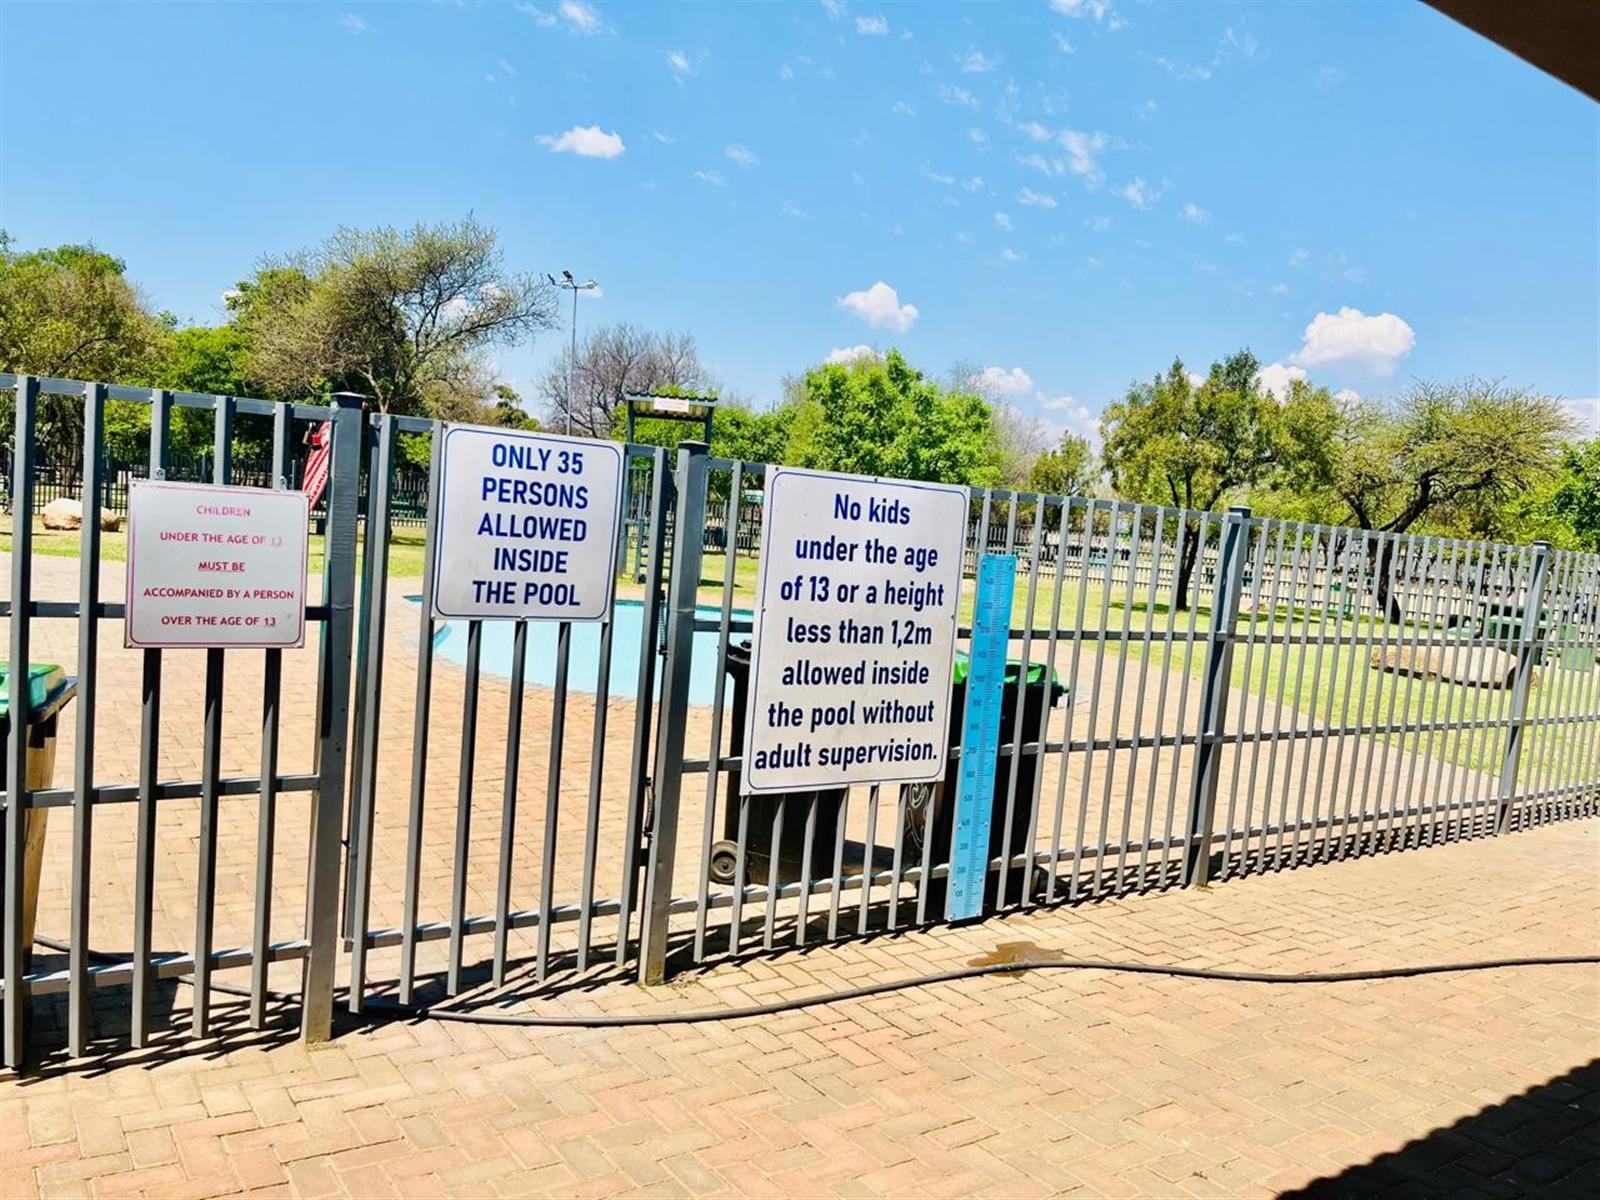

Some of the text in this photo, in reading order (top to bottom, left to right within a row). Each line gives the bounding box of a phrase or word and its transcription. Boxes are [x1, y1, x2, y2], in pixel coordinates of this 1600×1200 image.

[492, 444, 584, 475] ONLY 35
[482, 476, 588, 509] PERSONS
[196, 505, 251, 517] CHILDREN
[834, 493, 911, 525] No kids
[160, 532, 198, 542] UNDER
[202, 533, 224, 543] THE
[226, 534, 249, 544] AGE
[252, 536, 266, 545] OF
[478, 512, 588, 542] ALLOWED
[198, 562, 246, 572] MUST BE
[494, 547, 568, 574] INSIDE
[795, 535, 938, 572] under the age
[144, 588, 224, 598] ACCOMPANIED
[227, 590, 240, 598] BY
[254, 591, 294, 600] PERSON
[472, 580, 581, 606] THE POOL
[780, 575, 944, 612] of 13 or a height
[162, 616, 276, 628] OVER THE AGE OF 13
[786, 617, 932, 648] less than 1,2m
[782, 660, 930, 686] allowed inside
[768, 700, 934, 733] the pool without
[754, 738, 938, 772] adult supervision.
